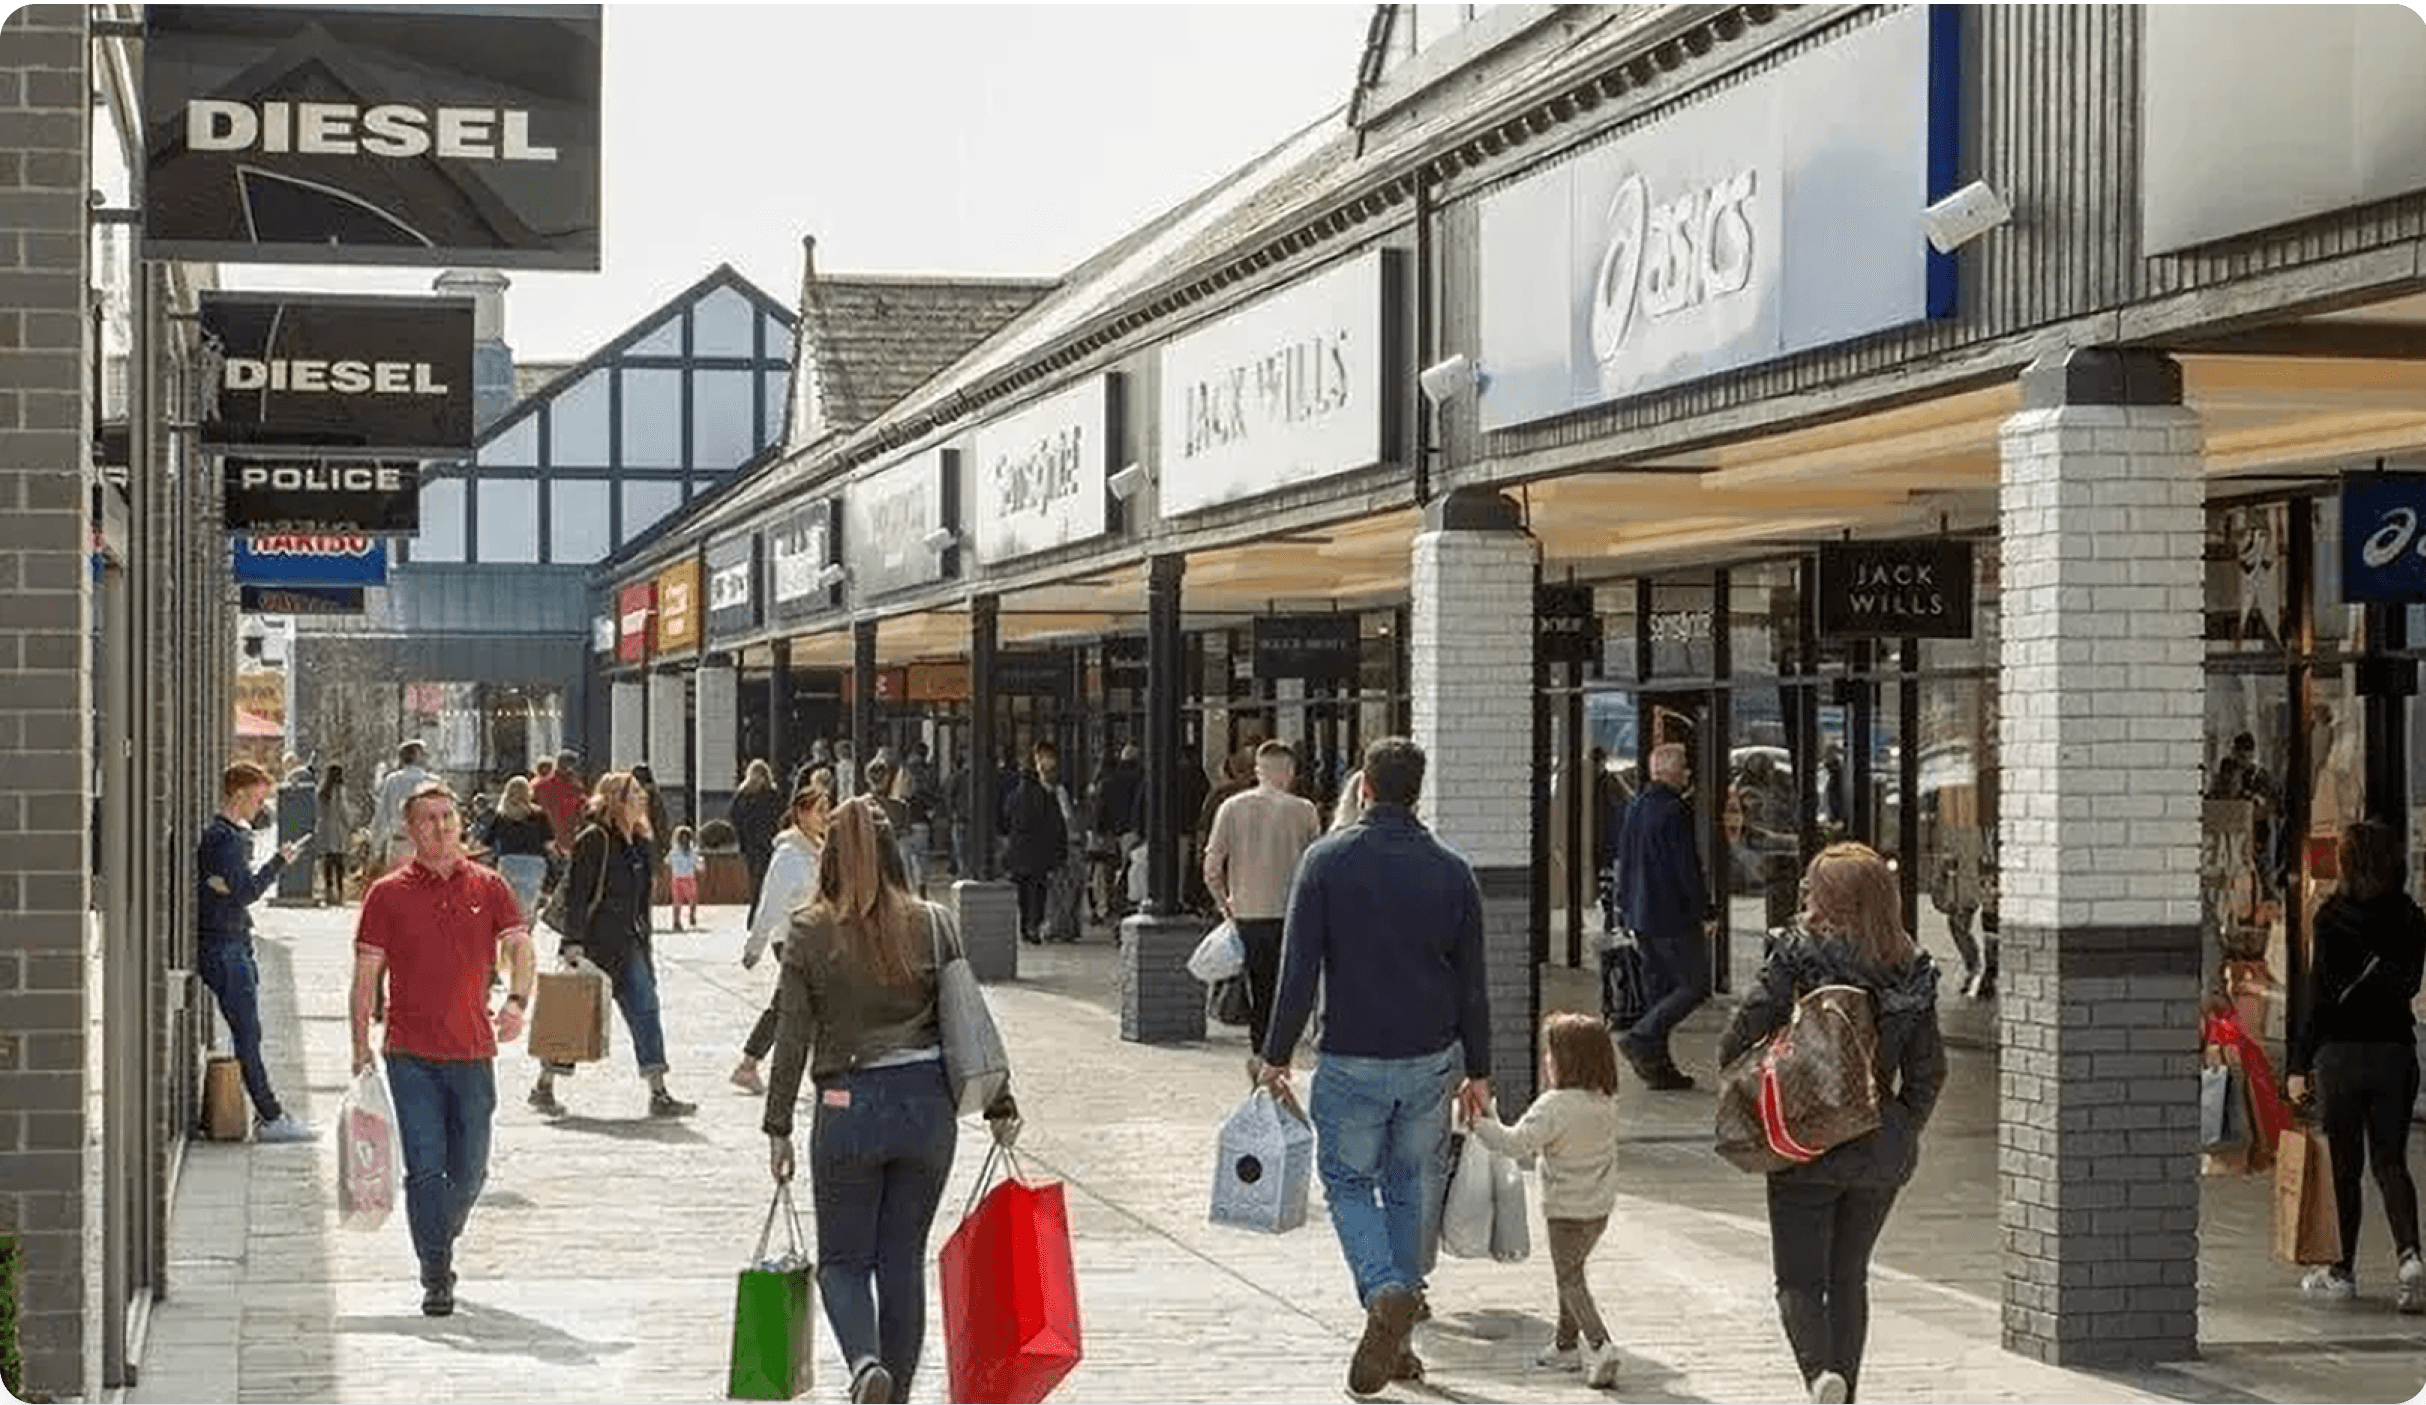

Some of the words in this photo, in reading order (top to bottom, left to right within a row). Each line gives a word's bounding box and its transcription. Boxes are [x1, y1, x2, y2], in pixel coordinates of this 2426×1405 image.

[185, 98, 558, 161] DIESEL
[224, 358, 448, 395] DIESEL
[1183, 366, 1248, 458] JACK
[1253, 328, 1350, 425] WILLS
[241, 467, 401, 491] POLICE
[1857, 564, 1933, 586] JACK
[1850, 593, 1944, 616] WILLS
